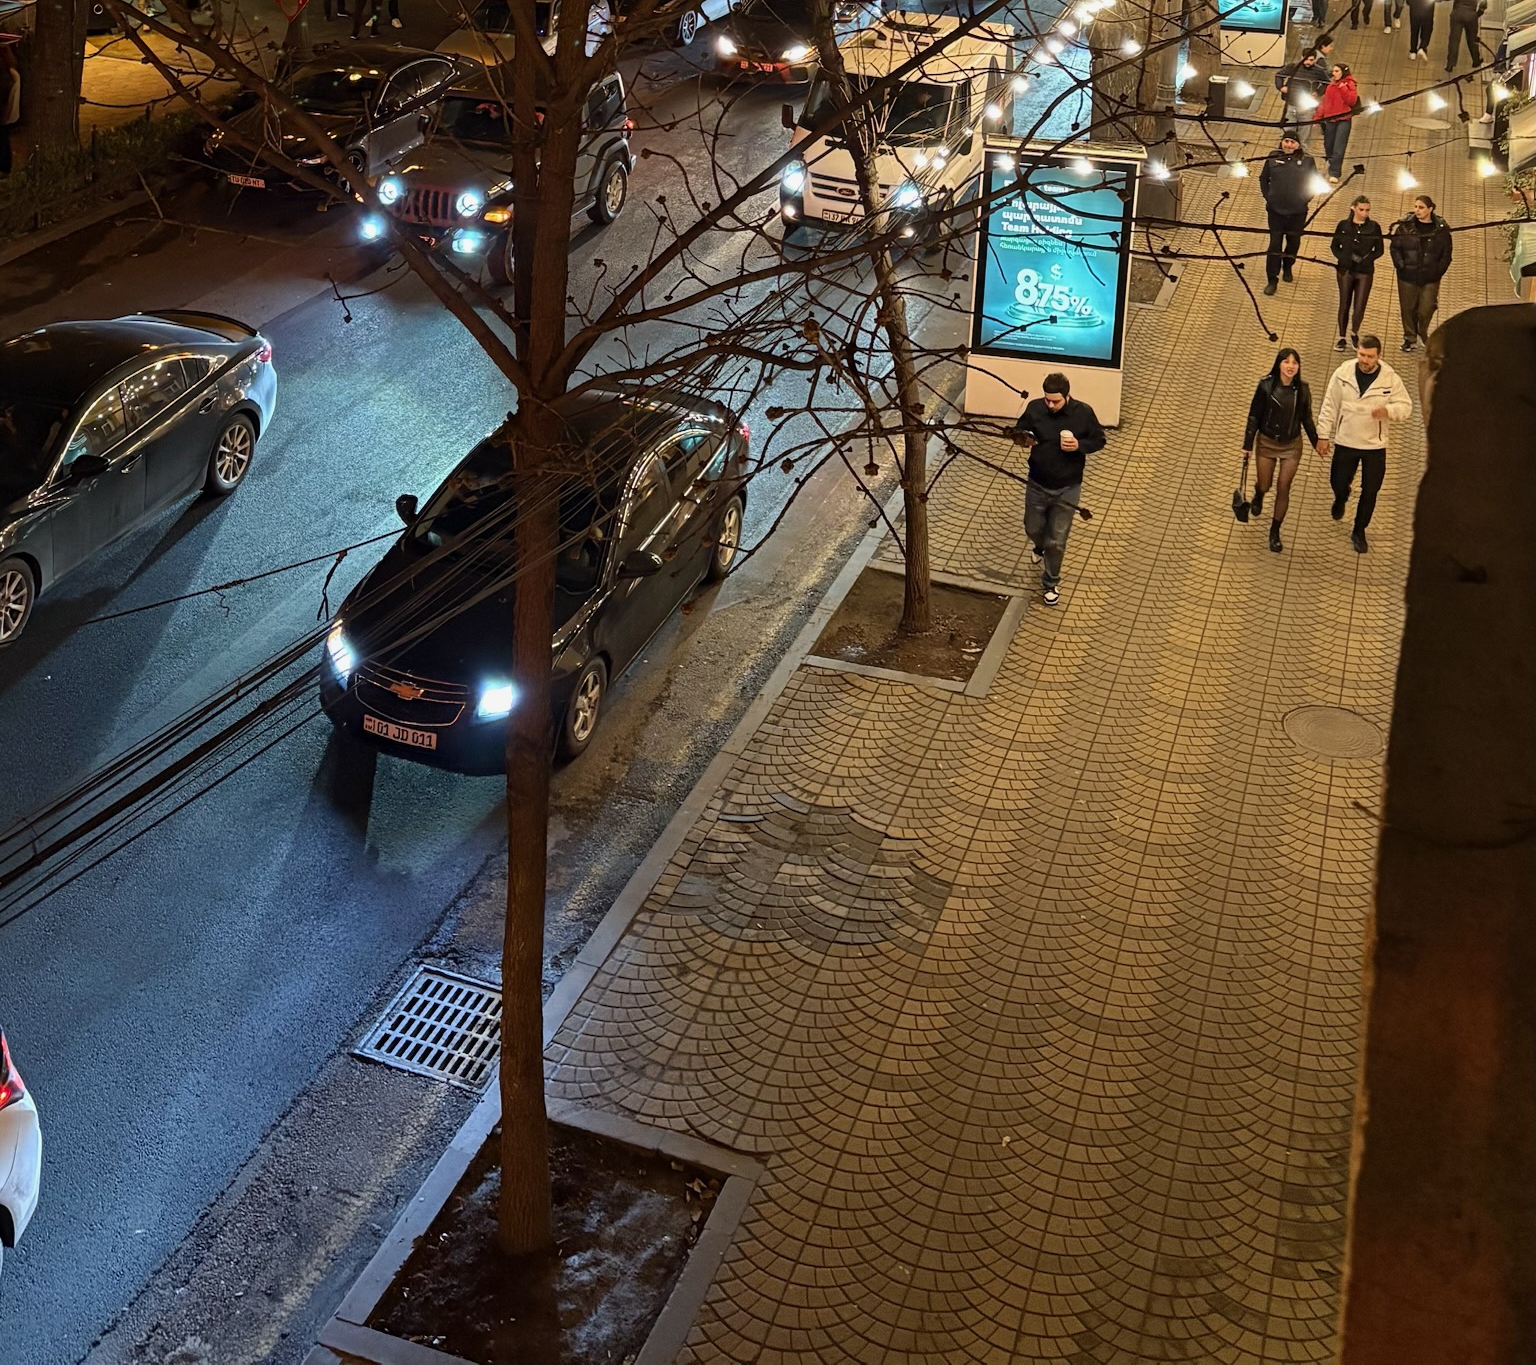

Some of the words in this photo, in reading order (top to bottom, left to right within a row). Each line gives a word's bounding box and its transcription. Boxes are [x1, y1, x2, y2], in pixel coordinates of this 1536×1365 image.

[1001, 221, 1030, 234] Team
[1050, 263, 1063, 281] $
[376, 721, 390, 737] 01
[393, 726, 409, 742] JD
[412, 732, 432, 746] 011
